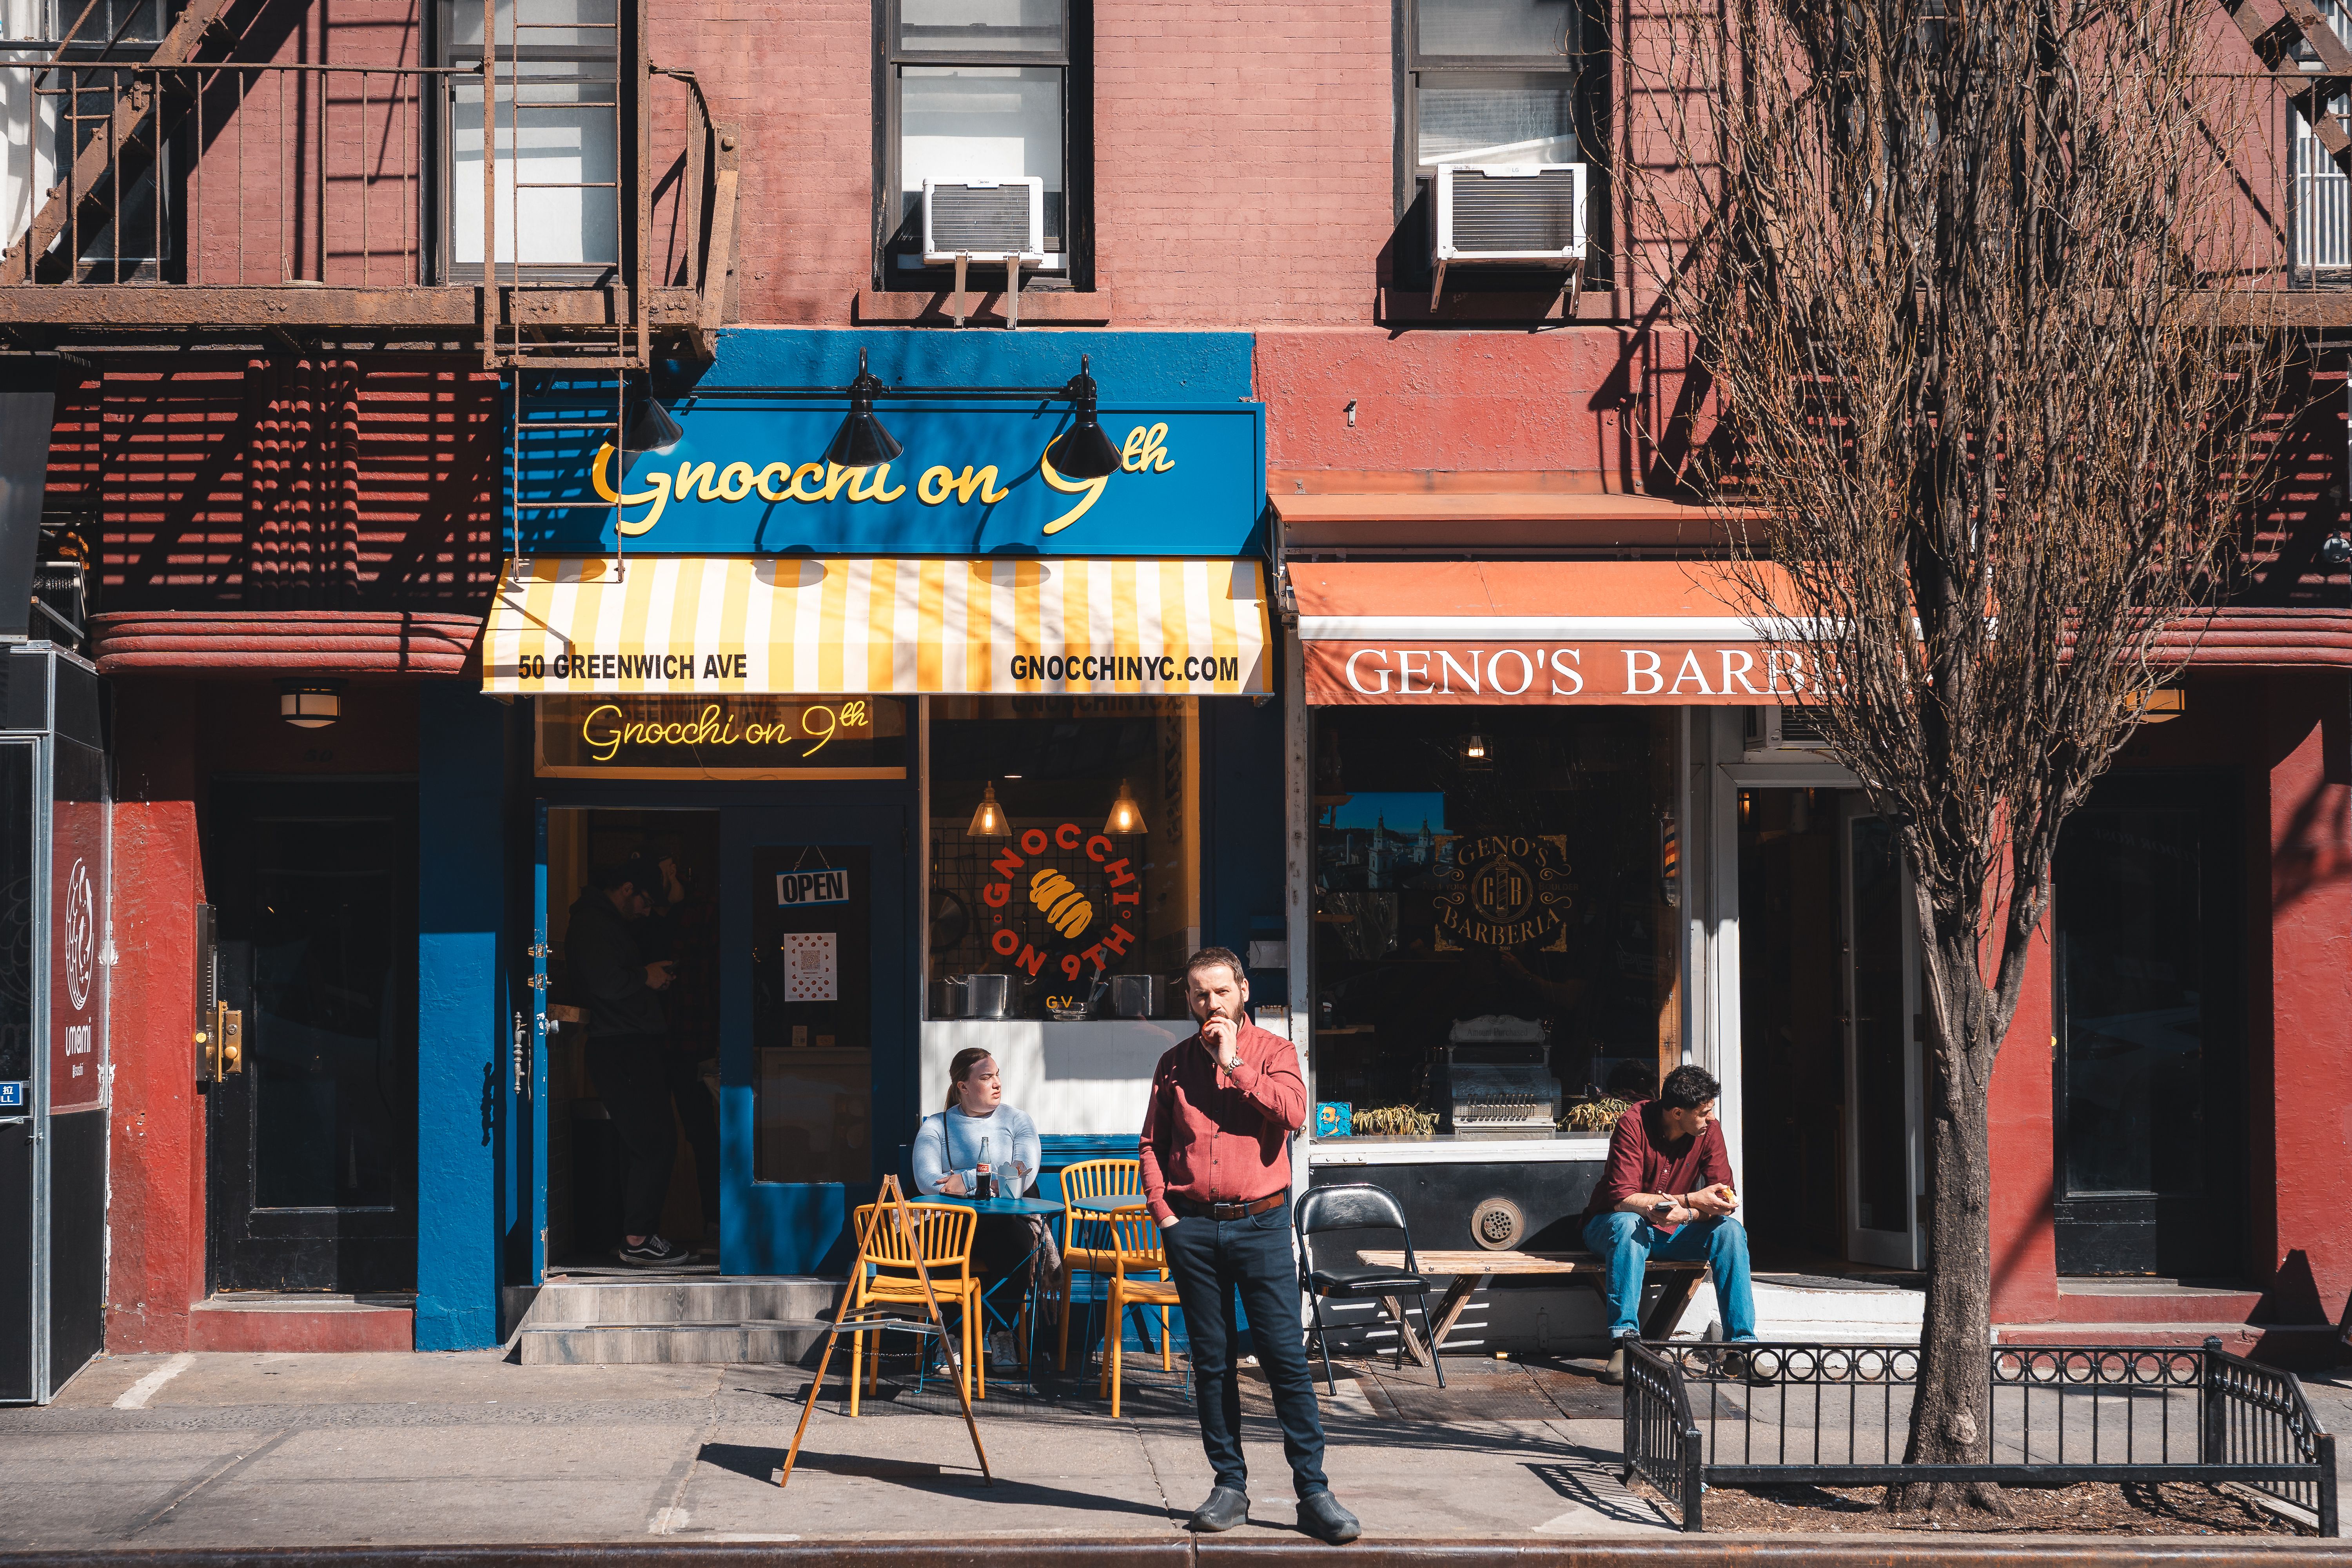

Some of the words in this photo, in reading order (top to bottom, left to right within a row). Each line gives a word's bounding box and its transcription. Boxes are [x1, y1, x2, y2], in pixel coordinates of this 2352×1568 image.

[592, 441, 906, 535] Gnocchi
[918, 465, 1009, 505] on
[1041, 422, 1175, 534] 9th
[518, 655, 545, 679] 50
[553, 654, 694, 679] GREENWICH
[703, 654, 747, 679] AVE
[1011, 655, 1238, 681] GNOCCHINYC.COM
[1345, 648, 1584, 696] GENO'S
[583, 704, 739, 761] Gnocchi
[745, 723, 792, 744] on
[802, 700, 869, 757] 9th
[983, 823, 1139, 907] GNOCCHI
[1458, 835, 1548, 867] GENO'S
[782, 871, 844, 903] OPEN
[1483, 877, 1493, 906] G
[1510, 877, 1521, 905] B
[1443, 905, 1561, 945] BARBERIA
[992, 929, 1047, 976] ON
[1061, 924, 1135, 981] 9TH
[1046, 996, 1073, 1009] GV
[65, 1016, 91, 1056] umami
[1466, 1028, 1491, 1037] Amount
[1494, 1027, 1528, 1037] Purchased
[3, 1085, 14, 1095] 拉
